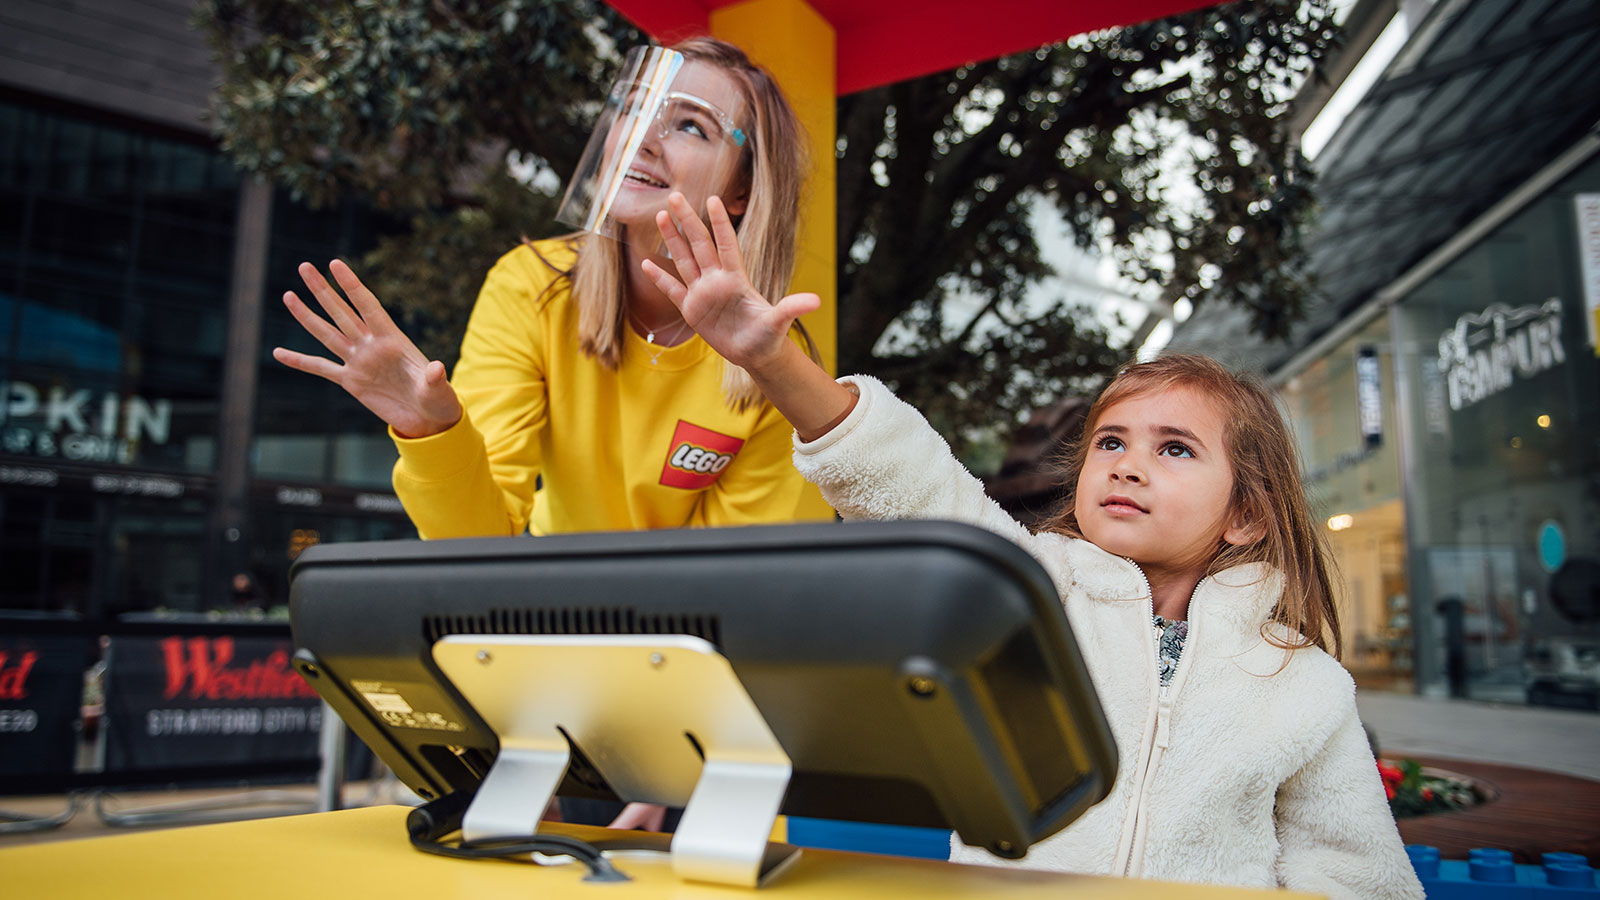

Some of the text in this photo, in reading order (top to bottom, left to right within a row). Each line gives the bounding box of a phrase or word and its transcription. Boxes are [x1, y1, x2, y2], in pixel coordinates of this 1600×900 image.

[671, 444, 732, 473] LEGO
[147, 708, 262, 735] STRATFORD
[264, 706, 306, 733] CITY
